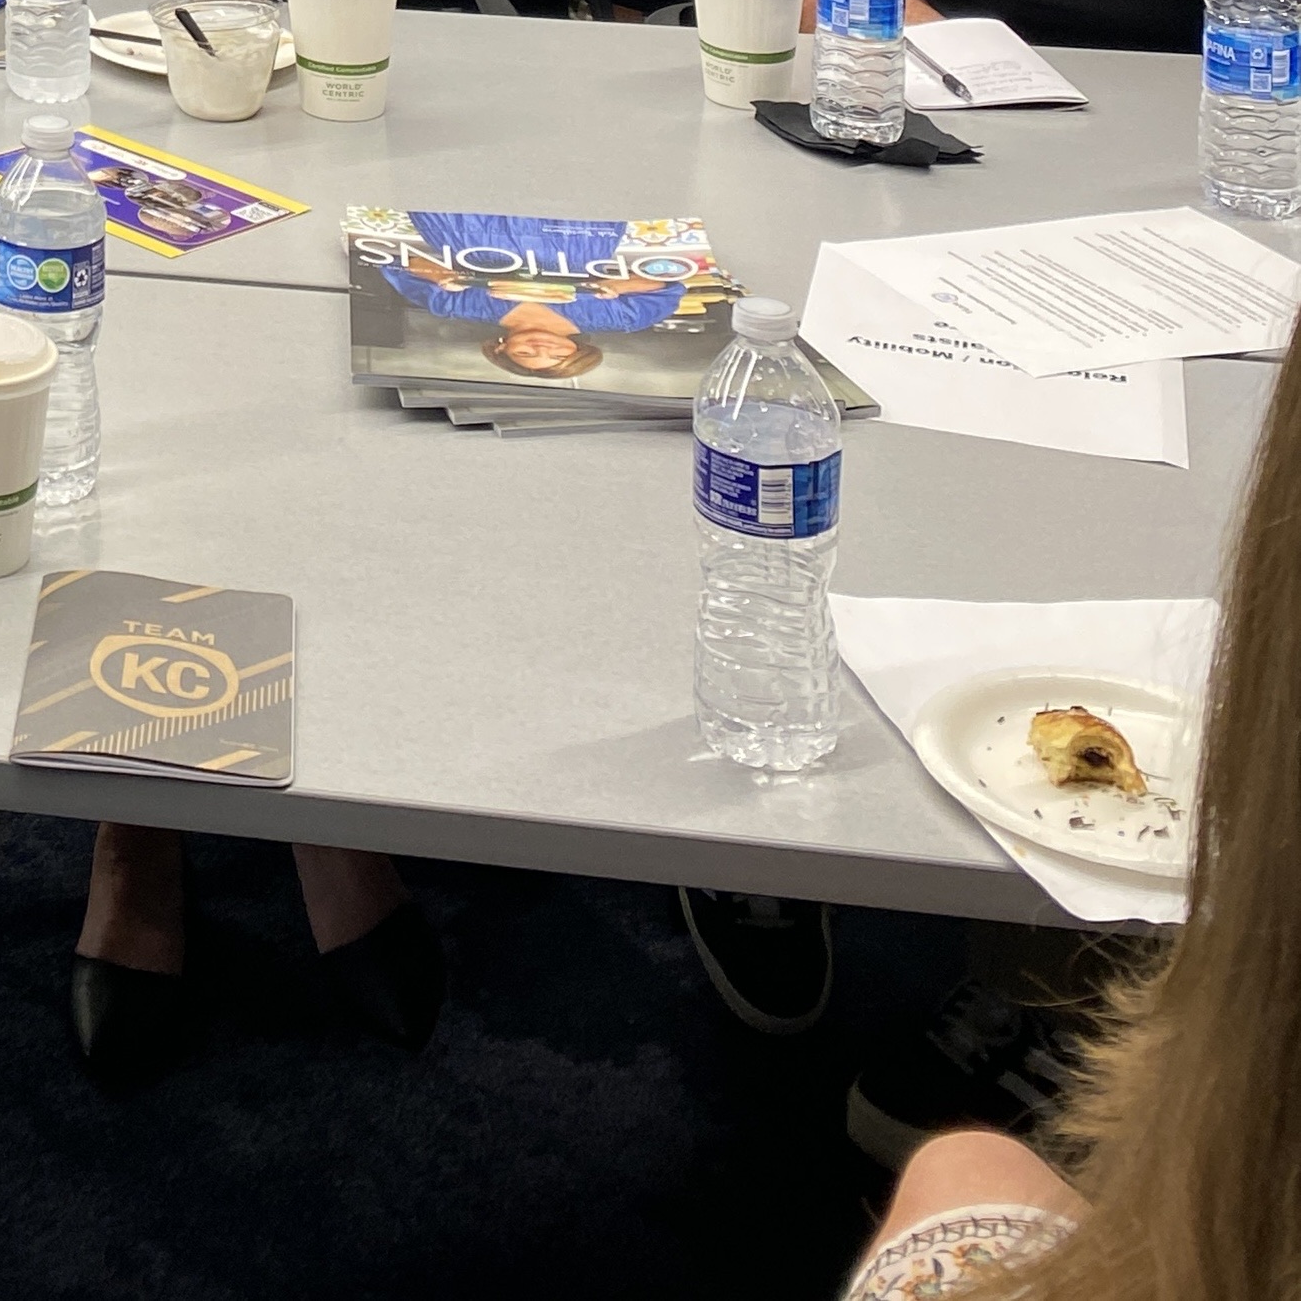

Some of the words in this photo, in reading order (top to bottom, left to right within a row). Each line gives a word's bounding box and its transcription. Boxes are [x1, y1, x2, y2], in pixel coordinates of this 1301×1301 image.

[321, 89, 365, 98] CENTRIC
[325, 81, 362, 91] WORLD
[353, 237, 699, 282] OPTIONS
[848, 335, 954, 361] Mobility
[122, 619, 216, 646] TEAM
[120, 651, 211, 701] KC
